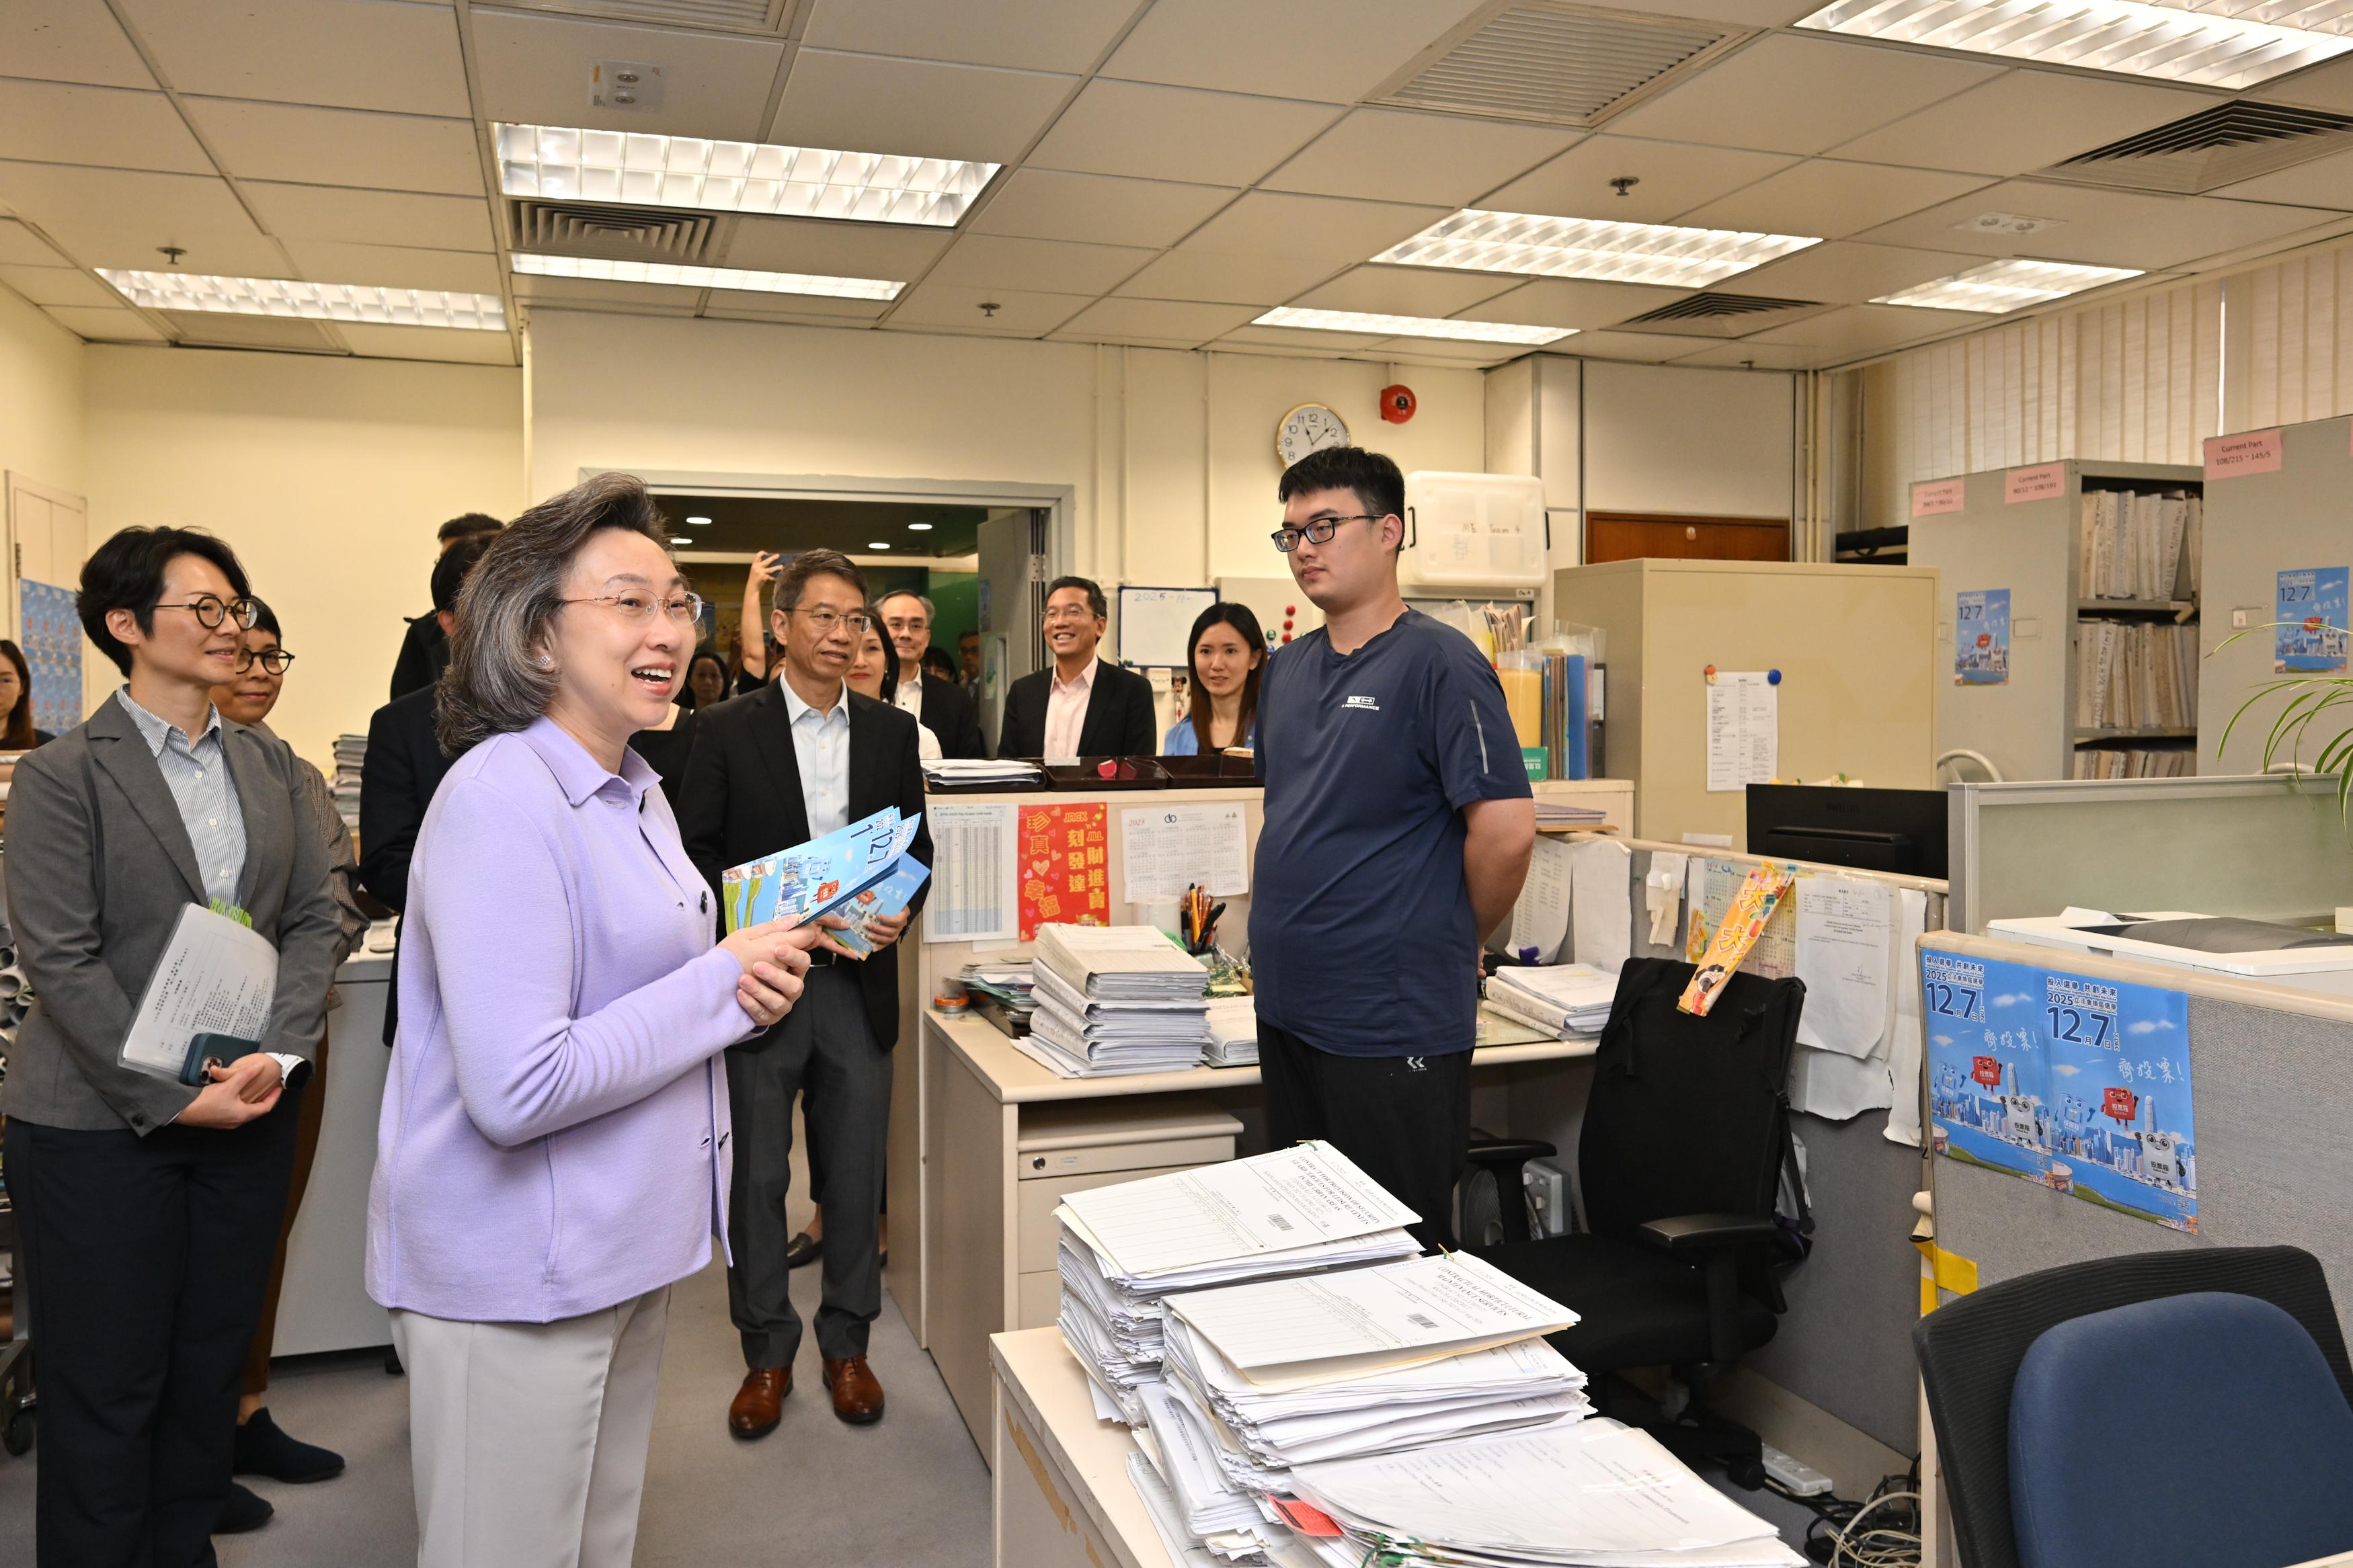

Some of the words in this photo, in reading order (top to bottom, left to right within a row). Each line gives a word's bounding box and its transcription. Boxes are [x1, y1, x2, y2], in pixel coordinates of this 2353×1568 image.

[1298, 415, 1304, 424] 11
[1308, 414, 1318, 423] 12
[1324, 418, 1326, 426] 1
[1288, 425, 1298, 434] 10
[1330, 428, 1337, 437] 2
[1285, 438, 1292, 447] 9
[2221, 444, 2247, 453] Current
[1288, 452, 1295, 460] 8
[2018, 474, 2038, 483] Current
[1489, 523, 1509, 534] Team
[1064, 811, 1088, 823] JACK
[1086, 831, 1104, 842] JILL
[1067, 829, 1086, 893] 刻發達
[1926, 956, 1952, 967] 投入選舉
[1956, 961, 1984, 973] 共創未來
[1926, 969, 1947, 981] 2025
[2048, 977, 2079, 989] 投入選舉
[2085, 984, 2117, 997] 共創未來
[2048, 993, 2073, 1005] 2025
[2112, 1104, 2128, 1112] 投票箱
[2014, 1122, 2030, 1131] 投票箱
[2151, 1161, 2169, 1171] 投票箱
[1300, 1156, 1322, 1174] CONTRAT
[1329, 1181, 1352, 1200] PROVISION
[1357, 1205, 1380, 1223] SECURITY
[1306, 1171, 1325, 1187] ERVICES
[1332, 1194, 1351, 1210] LEISURE
[1436, 1274, 1479, 1298] MAINTENANCE
[1476, 1298, 1509, 1315] SERVICES
[1438, 1266, 1480, 1290] CONTRACTUAL
[1478, 1290, 1533, 1320] HORTICULTURAL
